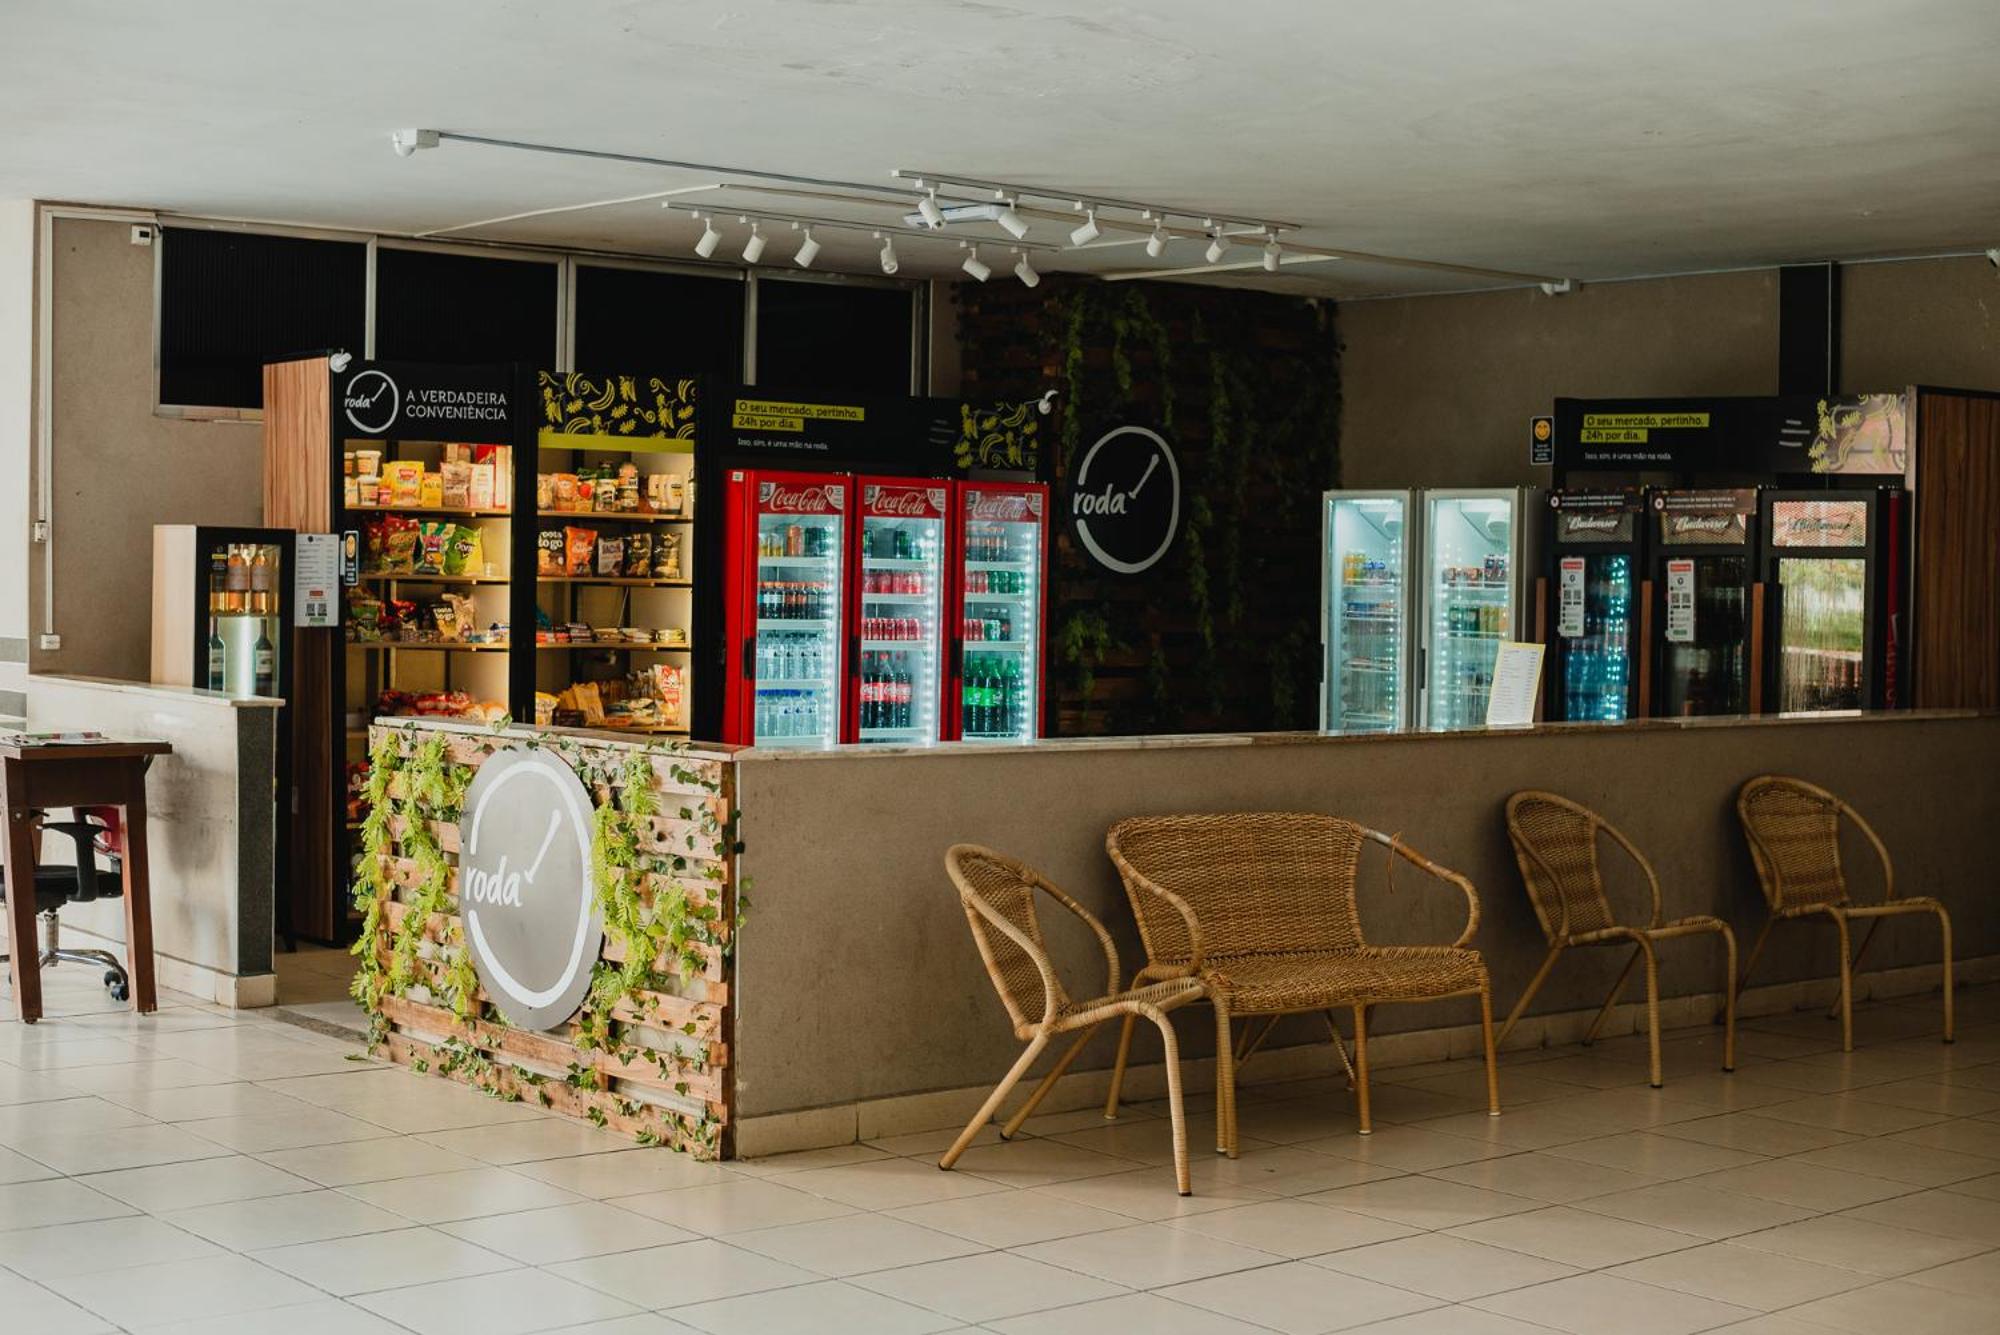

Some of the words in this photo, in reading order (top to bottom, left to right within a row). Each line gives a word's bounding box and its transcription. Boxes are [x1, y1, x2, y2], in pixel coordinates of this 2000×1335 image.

[344, 394, 371, 408] roda
[406, 389, 416, 402] A
[420, 390, 507, 406] VERDADEIRA
[406, 404, 507, 420] CONVENIÊNCIA
[739, 401, 747, 411] O
[750, 404, 767, 413] seu
[738, 416, 757, 426] 24h
[760, 418, 775, 429] por
[1587, 416, 1595, 425] O
[1597, 418, 1613, 426] seu
[1585, 430, 1603, 440] 24h
[1605, 432, 1621, 442] por
[1623, 430, 1640, 440] dia.
[1073, 483, 1127, 515] roda
[465, 855, 523, 907] roda
